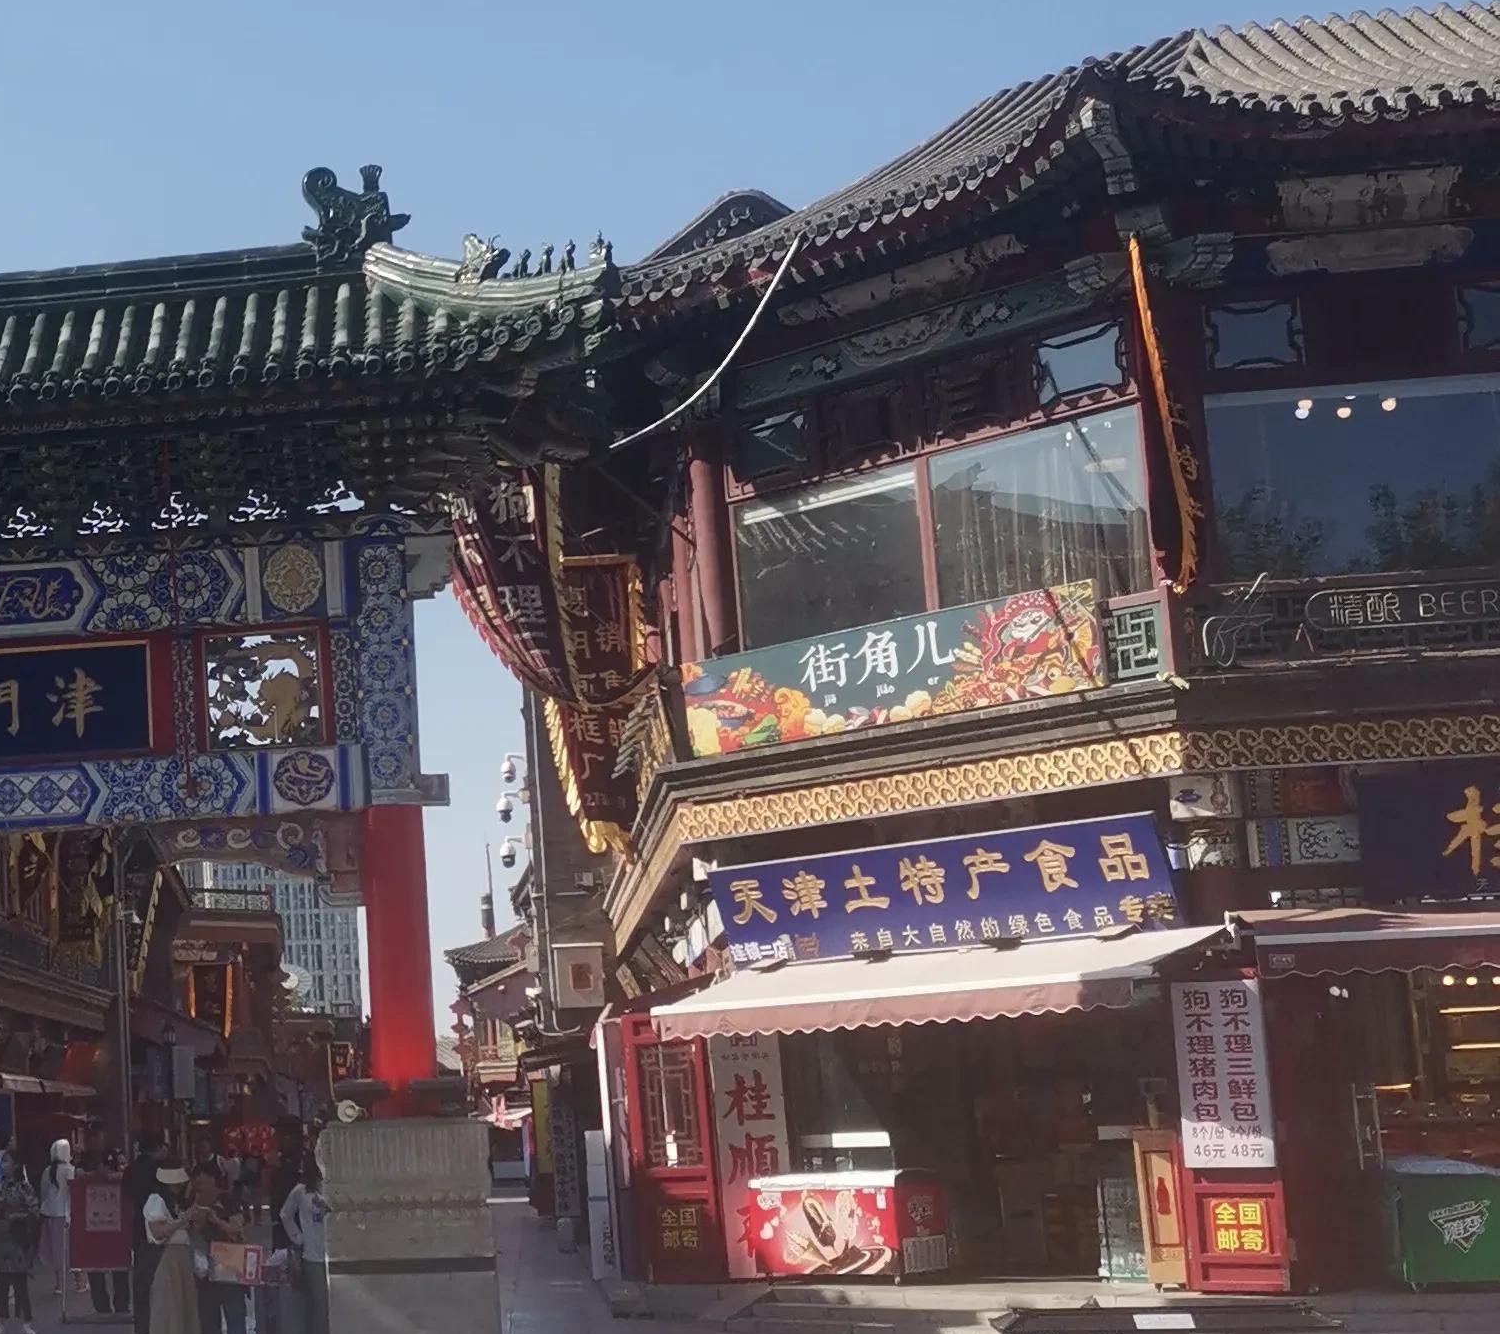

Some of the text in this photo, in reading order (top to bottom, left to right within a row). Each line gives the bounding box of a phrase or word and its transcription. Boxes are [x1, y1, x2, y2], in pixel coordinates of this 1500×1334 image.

[1329, 591, 1402, 625] 精酿
[798, 620, 956, 693] 街角儿
[729, 832, 1150, 925] 天津土特产食品
[1181, 988, 1222, 1123] 狗不理猪肉包
[1219, 988, 1259, 1122] 狗不理三鲜包
[1193, 1143, 1265, 1159] 46元 48元
[661, 1207, 698, 1227] 全国
[1215, 1202, 1262, 1225] 全国
[1216, 1227, 1264, 1251] 邮寄
